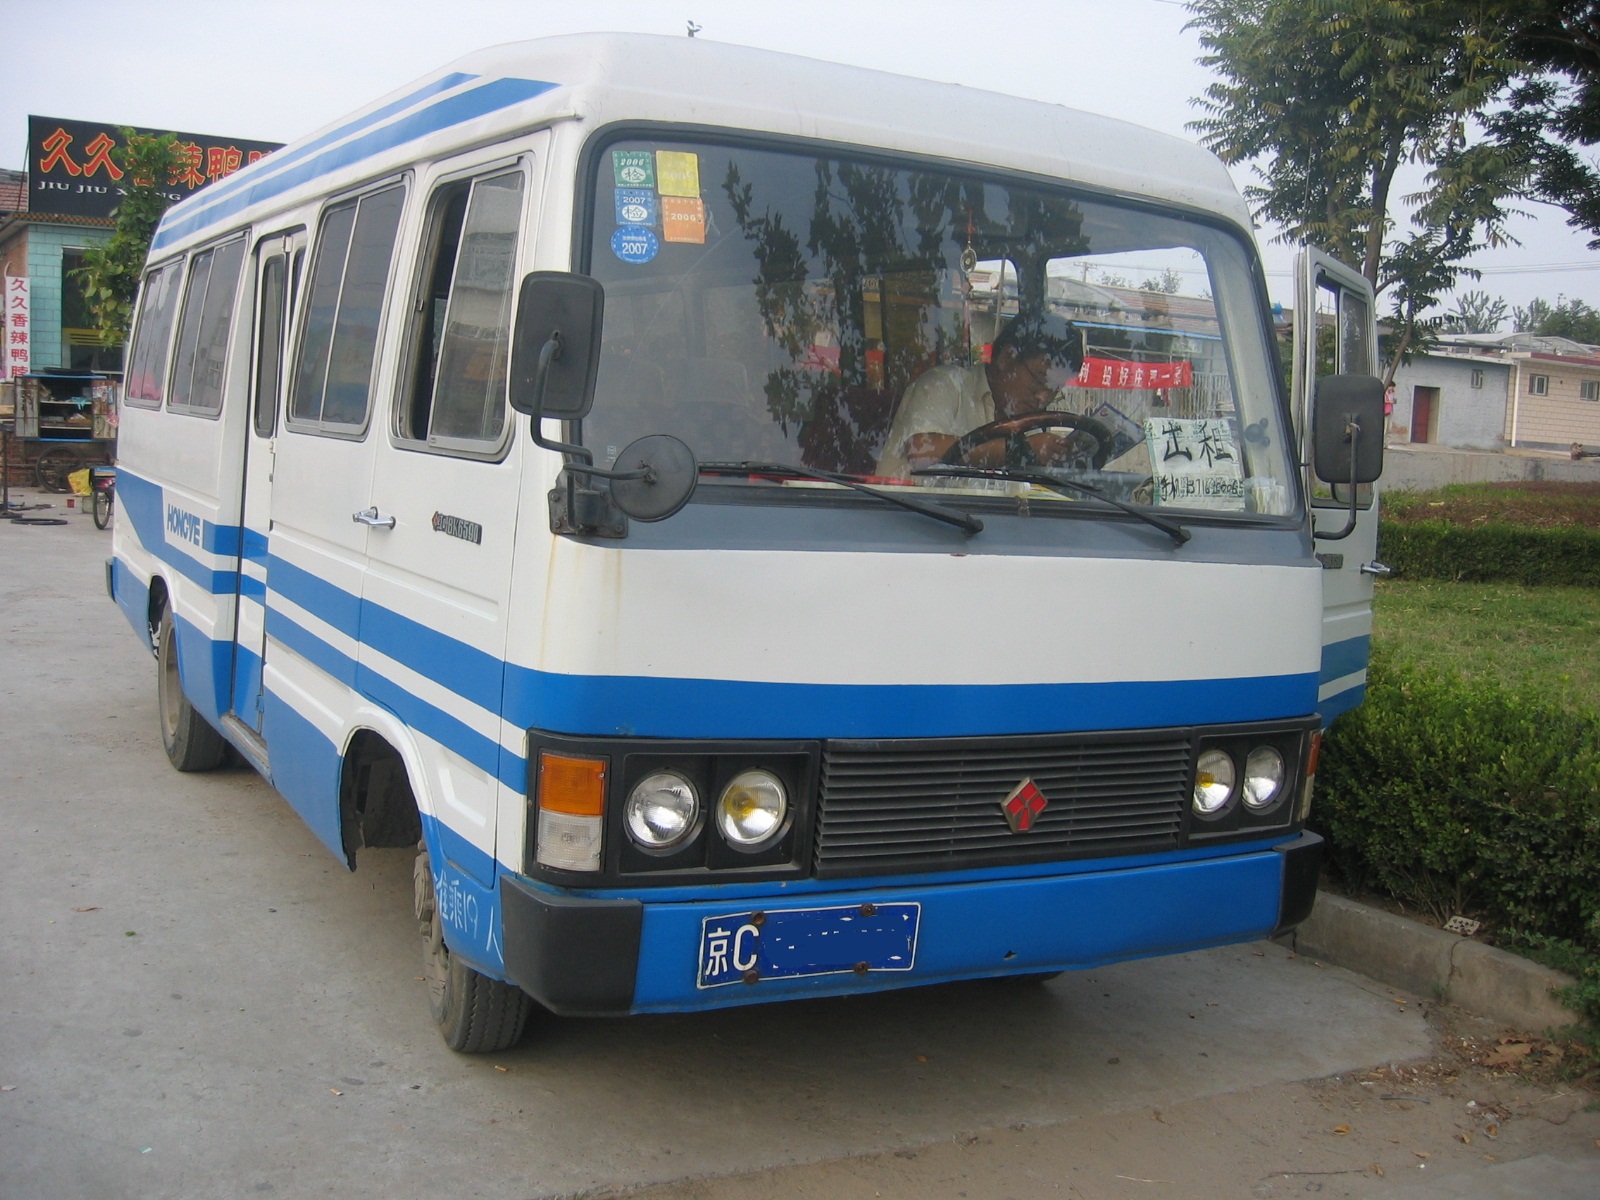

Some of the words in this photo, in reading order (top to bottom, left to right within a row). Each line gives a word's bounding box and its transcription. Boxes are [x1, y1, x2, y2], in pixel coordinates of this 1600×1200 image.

[620, 158, 645, 166] 2006
[38, 180, 70, 190] JIU
[76, 185, 109, 195] JIU
[623, 196, 646, 204] 2007
[621, 242, 648, 255] 2007
[1162, 421, 1234, 468] 出租
[167, 503, 201, 546] HONGYE
